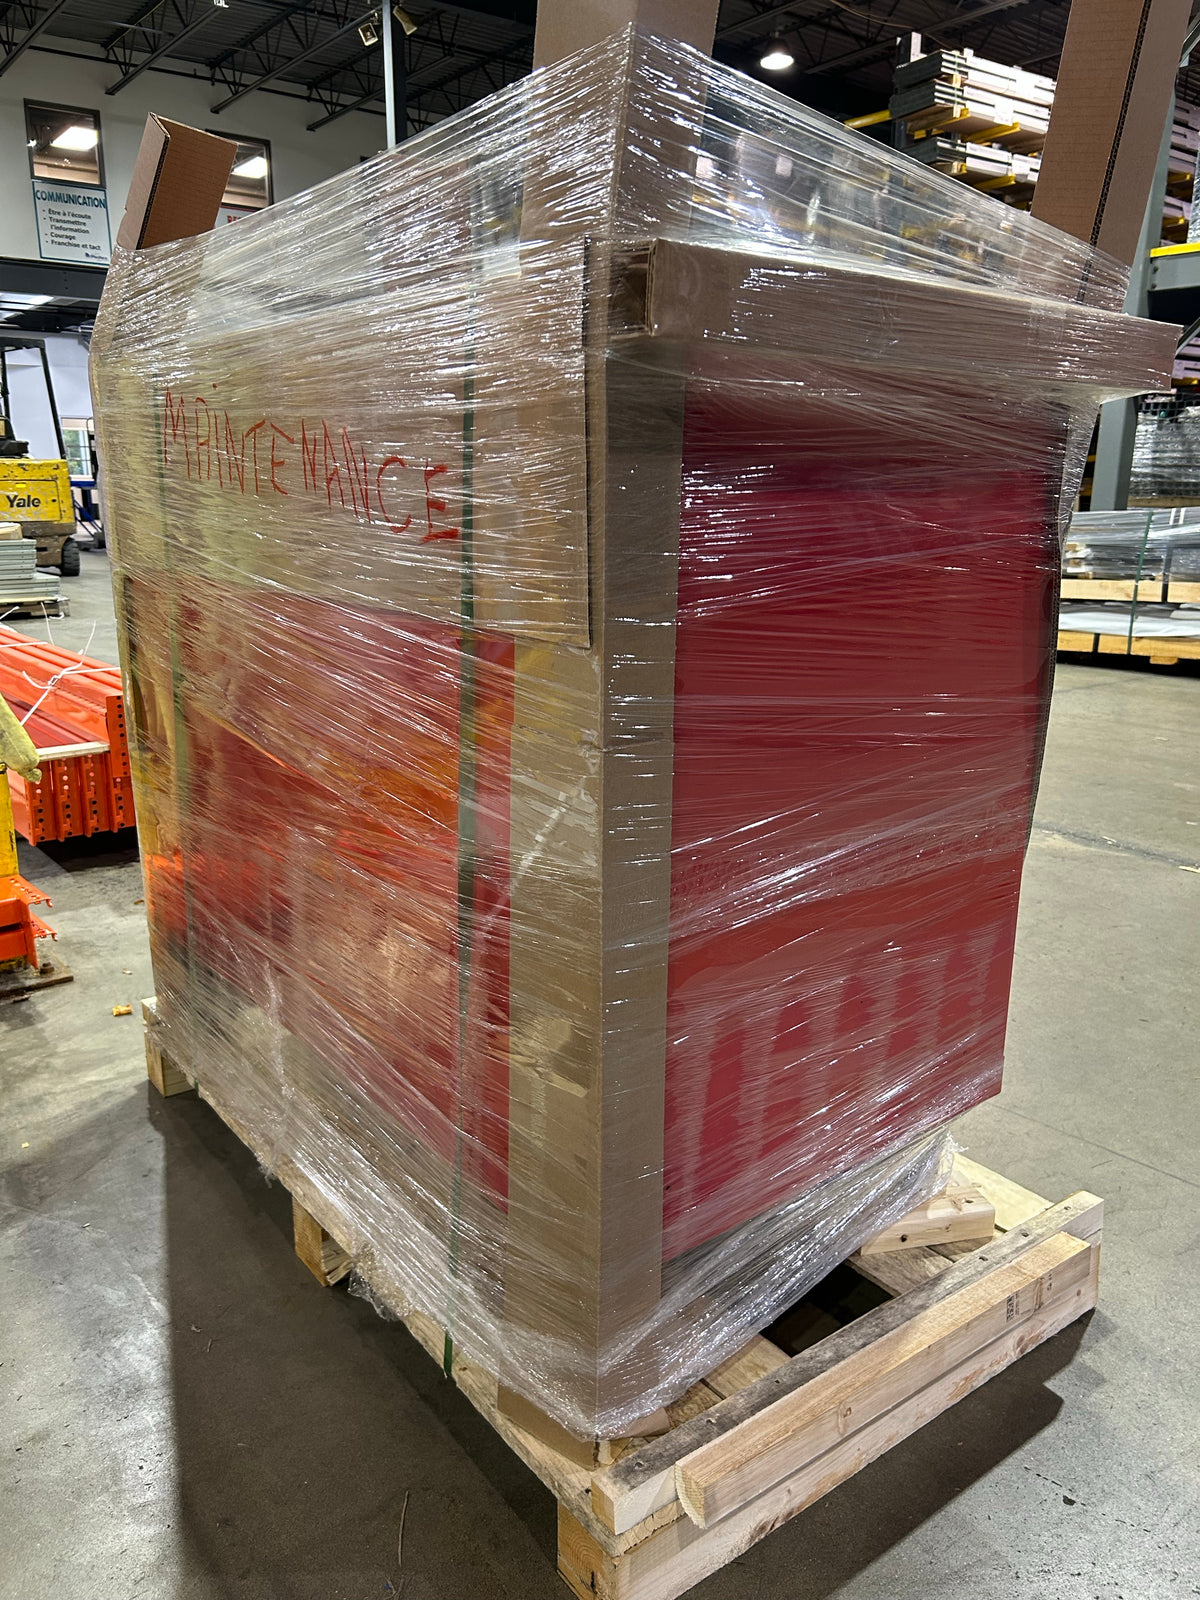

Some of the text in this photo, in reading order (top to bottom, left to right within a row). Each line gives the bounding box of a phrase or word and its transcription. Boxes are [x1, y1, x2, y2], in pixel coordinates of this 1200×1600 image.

[35, 189, 106, 209] COMMUNICATION
[49, 216, 87, 226] Transmettre
[50, 225, 90, 234] l'information
[50, 232, 76, 241] Courage
[51, 240, 80, 248] Franchise
[163, 383, 460, 544] MAINTENANCE
[6, 494, 41, 508] Yale
